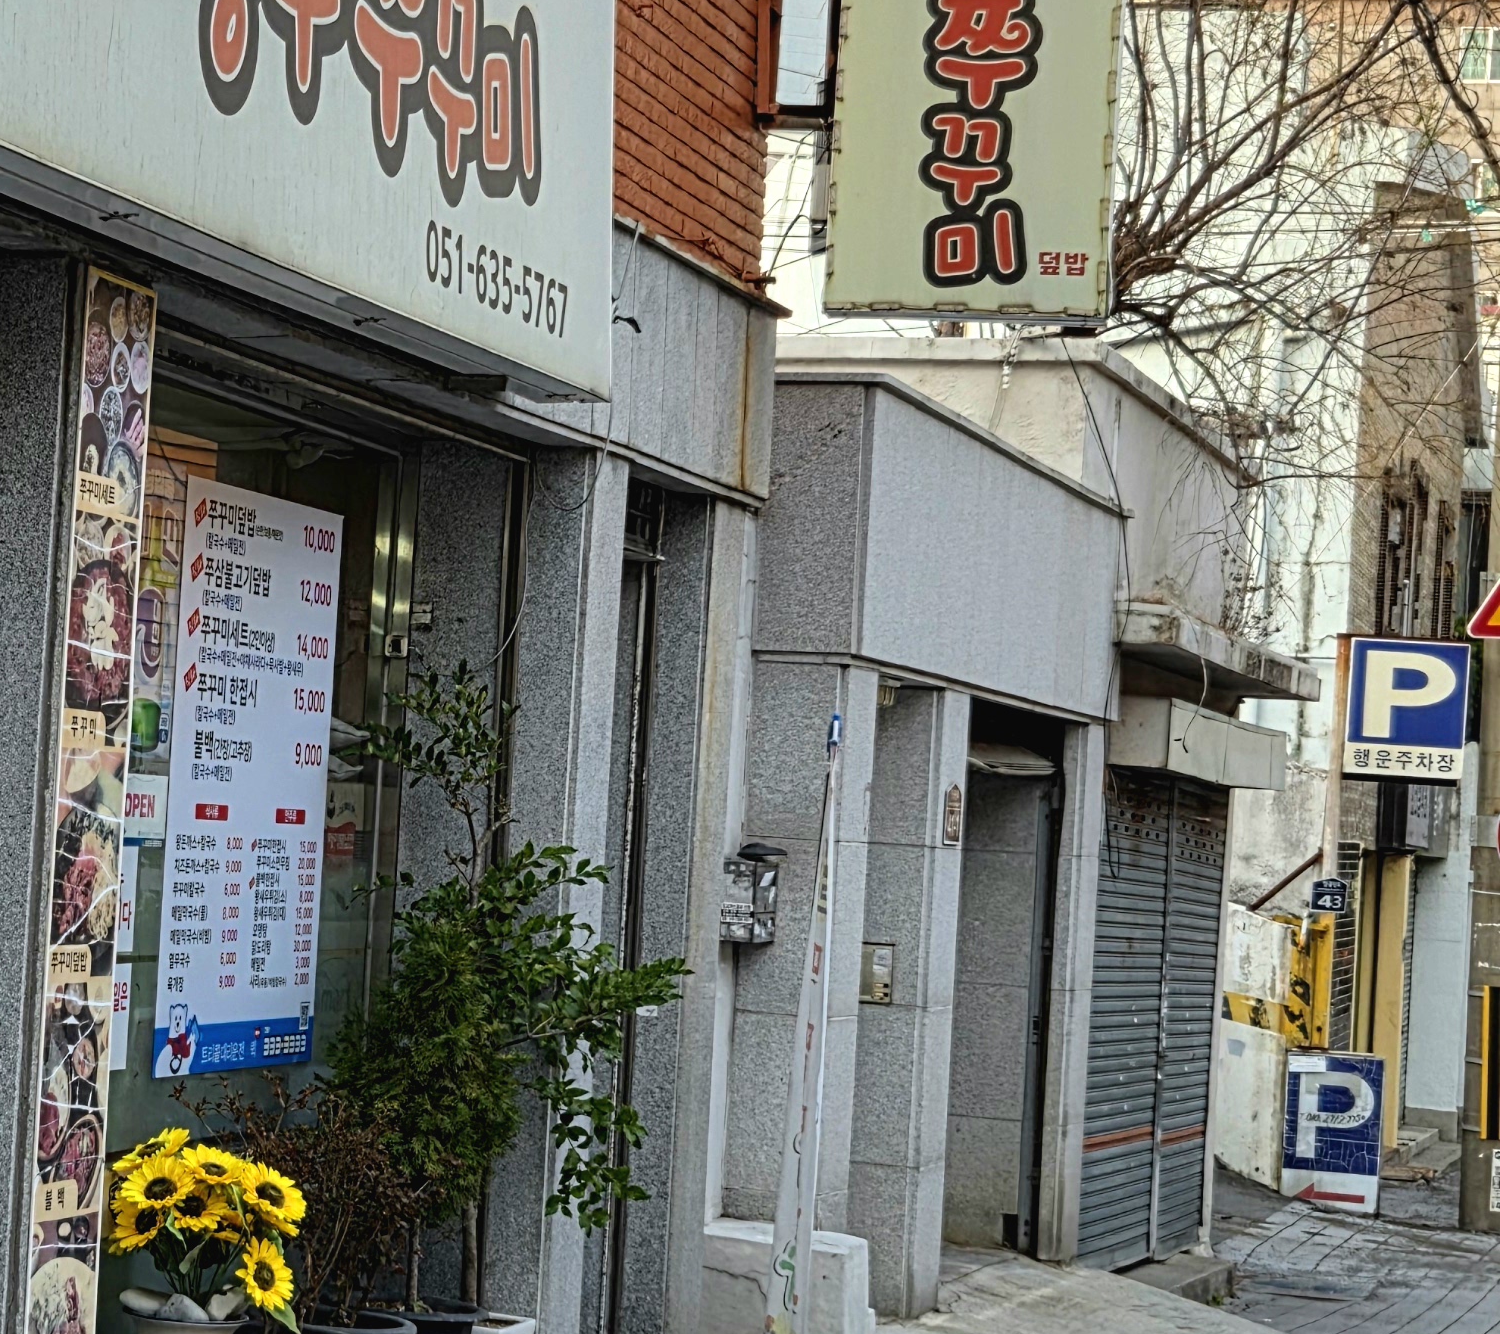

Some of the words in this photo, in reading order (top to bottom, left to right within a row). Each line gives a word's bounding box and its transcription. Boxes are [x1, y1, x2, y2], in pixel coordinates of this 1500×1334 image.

[1038, 250, 1089, 276] 덮밥
[427, 218, 569, 339] 051-635-5767
[80, 478, 115, 505] 쭈꾸미세트
[208, 499, 257, 537] 쭈꾸미덮밥
[304, 525, 335, 553] 10,000
[206, 532, 246, 556] (칼국수+메밀전)
[204, 557, 271, 597] 쭈삼불고기덮밥
[300, 580, 332, 607] 12,000
[202, 589, 243, 612] (칼국수+메밀전)
[297, 633, 328, 660] 14,000
[197, 673, 226, 704] 쭈꾸미
[230, 675, 258, 708] 한접시
[294, 688, 325, 715] 15,000
[1362, 650, 1456, 738] P
[71, 715, 97, 740] 쭈꾸미
[295, 742, 322, 769] 9,000
[1353, 748, 1455, 773] 행운주차장
[125, 792, 155, 818] OPEN
[226, 837, 243, 851] 8,000
[225, 860, 242, 874] 9,000
[224, 883, 240, 897] 6,000
[1317, 894, 1342, 909] 43
[222, 906, 239, 920] 8,000
[51, 951, 88, 974] 쭈꾸미덮밥
[220, 951, 237, 966] 6,000
[219, 975, 235, 989] 9,000
[1296, 1071, 1375, 1158] P
